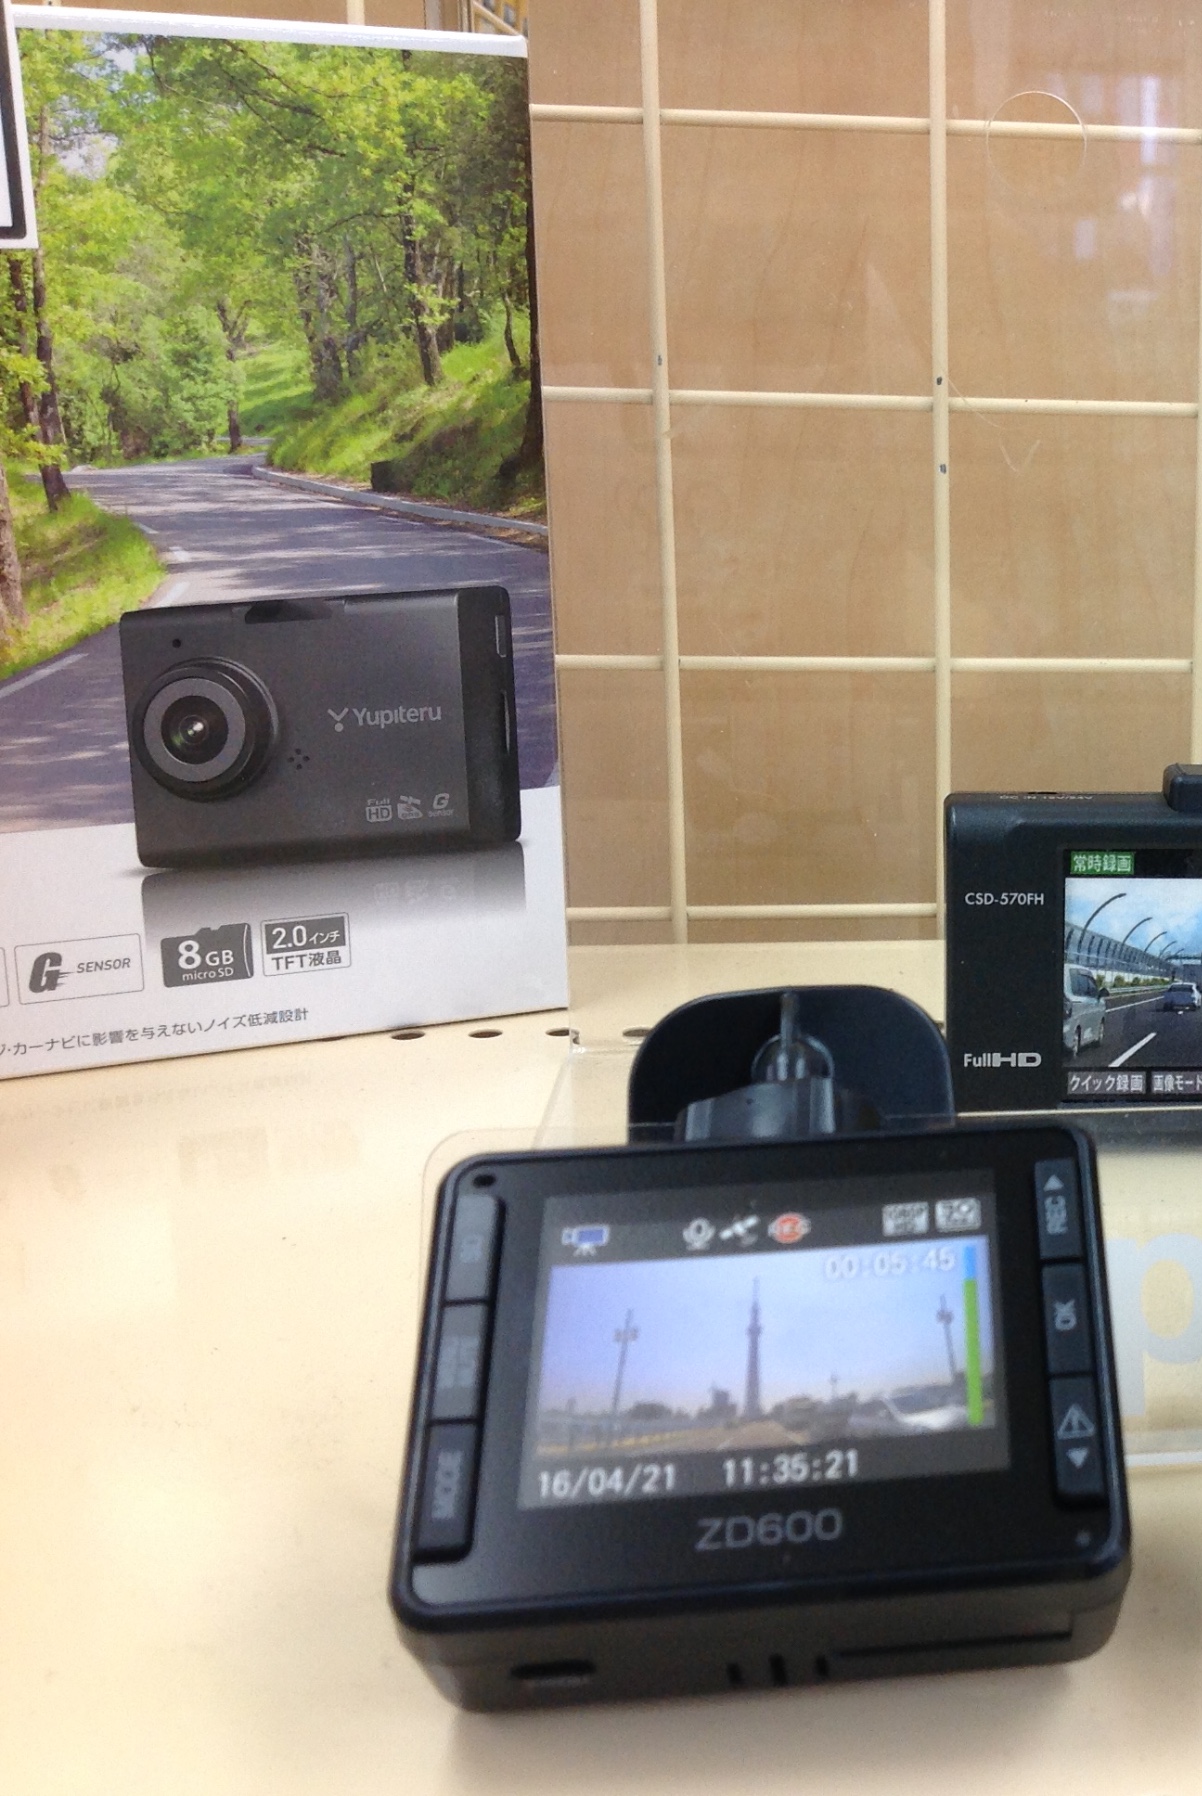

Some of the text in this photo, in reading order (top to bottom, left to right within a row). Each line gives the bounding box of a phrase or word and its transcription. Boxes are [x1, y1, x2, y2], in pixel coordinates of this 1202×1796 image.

[352, 705, 442, 729] Yupiteru
[367, 806, 392, 821] HD
[1072, 854, 1132, 873] 常時録画
[964, 892, 1045, 906] CSD-570FH
[76, 957, 132, 974] SENSOR
[271, 950, 342, 972] TFT液晶
[1070, 1074, 1144, 1093] クイック録画
[1054, 1300, 1078, 1331] OK
[538, 1448, 859, 1499] 16/04/21 11:35:21
[694, 1507, 844, 1551] ZD600
